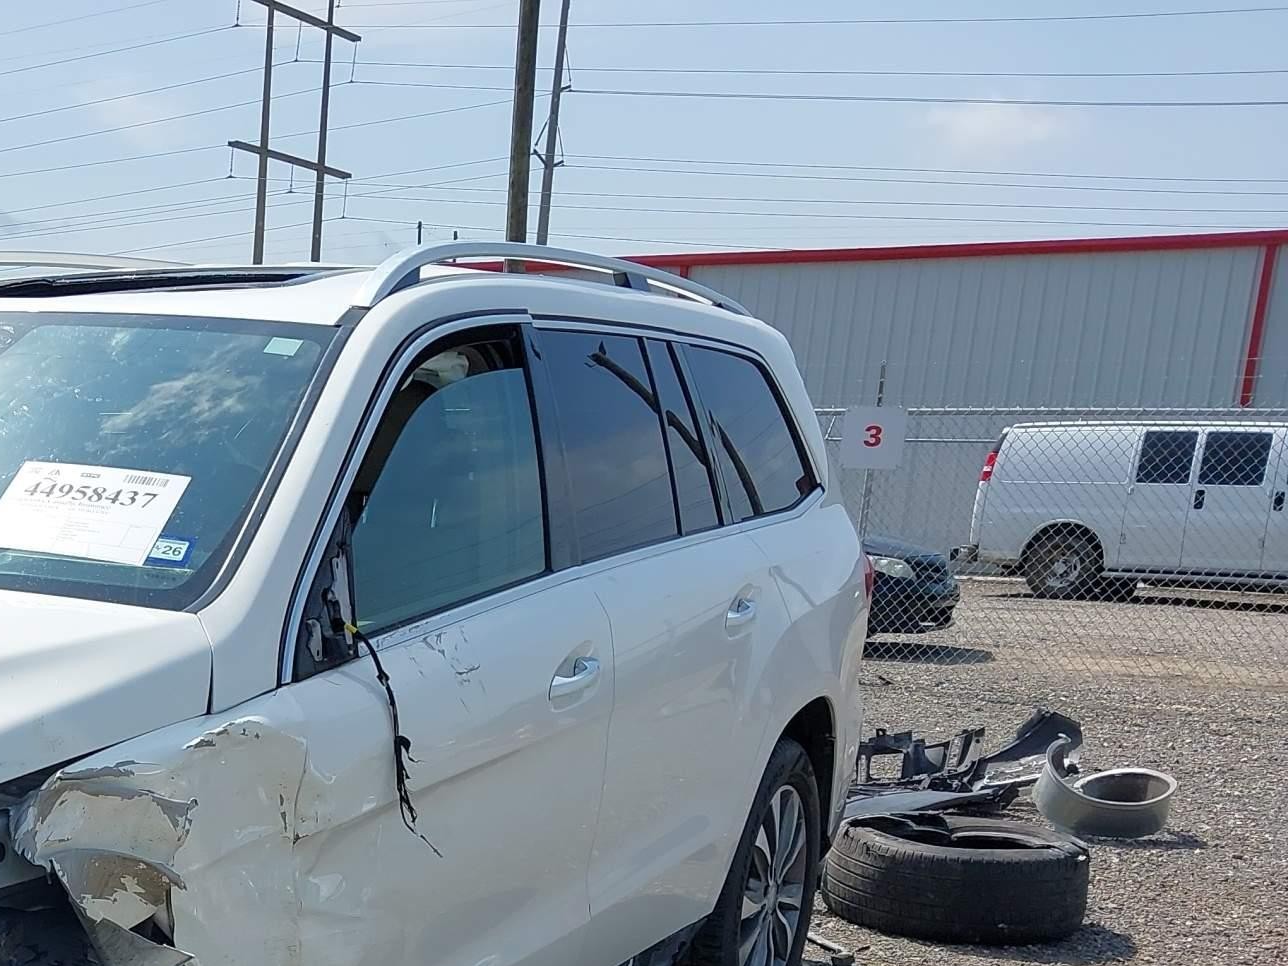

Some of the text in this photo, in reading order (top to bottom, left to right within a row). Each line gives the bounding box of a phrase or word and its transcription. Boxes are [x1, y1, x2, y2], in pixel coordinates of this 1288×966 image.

[863, 425, 882, 447] 3
[23, 481, 160, 509] 44958437
[161, 545, 183, 557] 26
